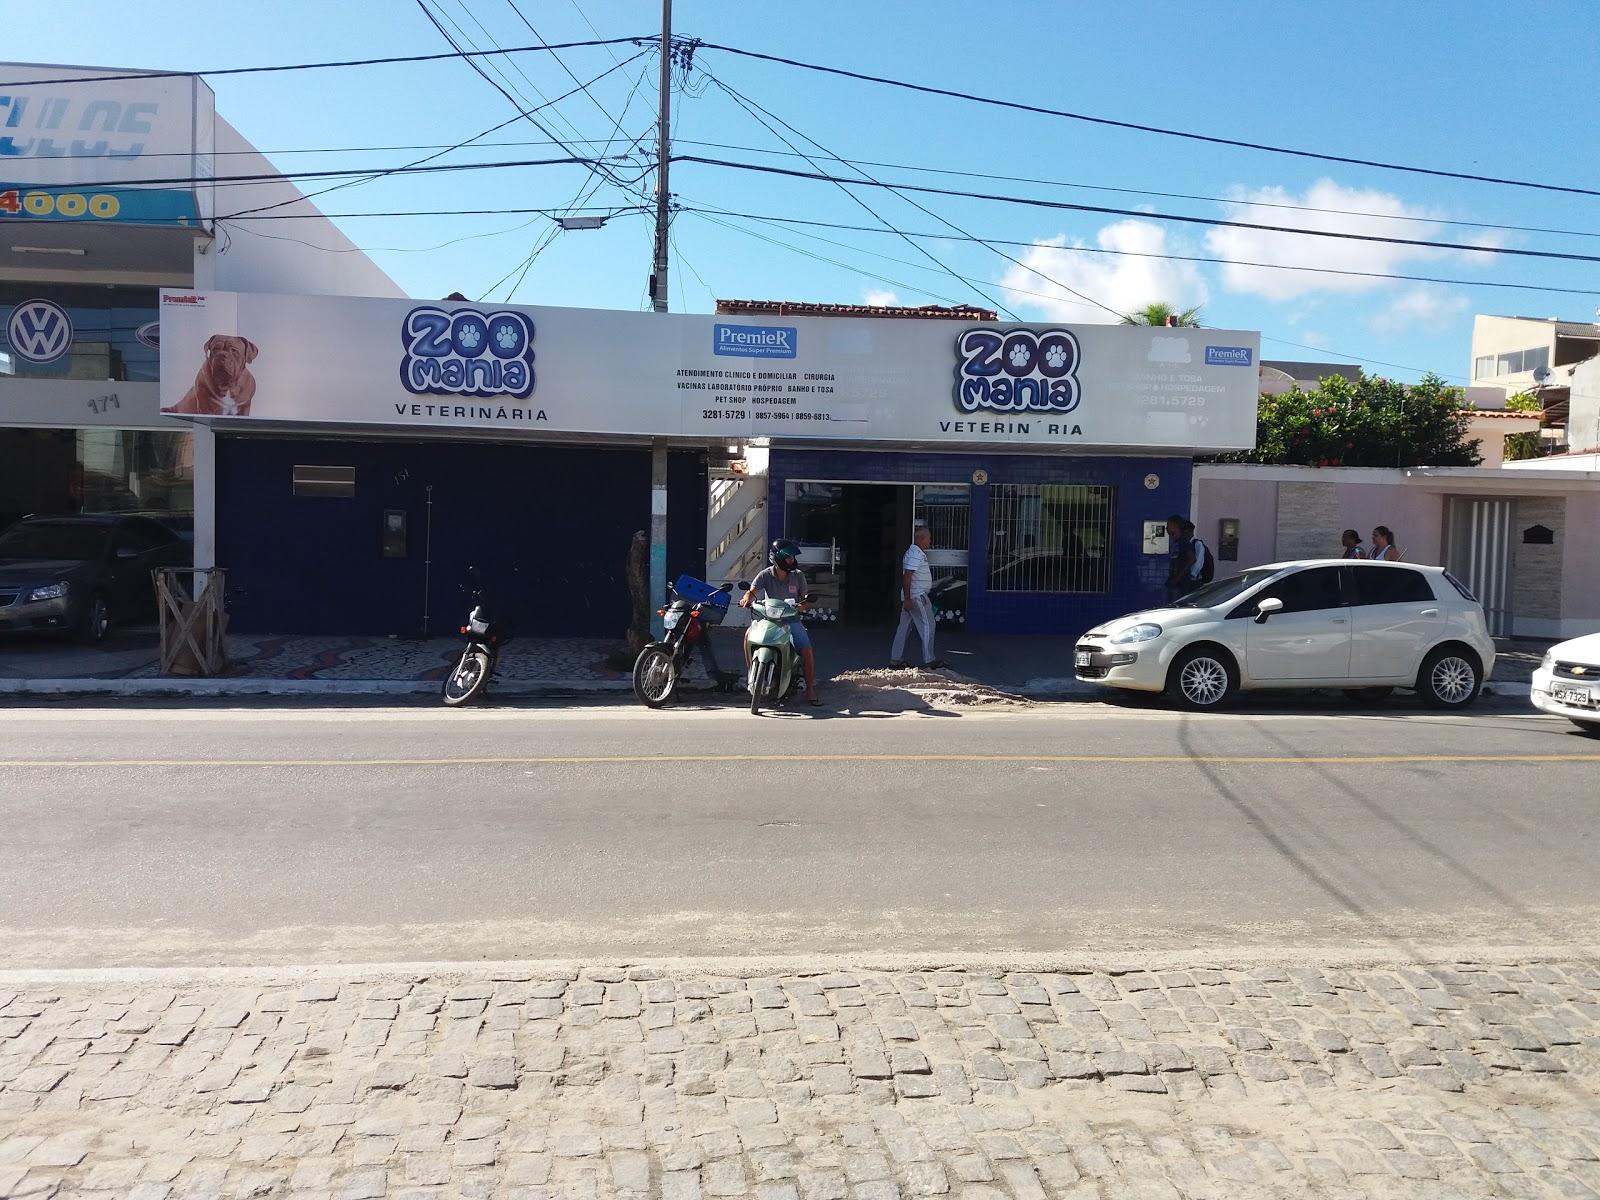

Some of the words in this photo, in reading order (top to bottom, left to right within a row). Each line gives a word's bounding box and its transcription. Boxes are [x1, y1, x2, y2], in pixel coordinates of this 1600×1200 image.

[411, 313, 526, 359] ZOO
[720, 327, 791, 349] PremieR
[719, 345, 748, 353] Alimentos
[964, 333, 1074, 378] ZOO
[676, 369, 723, 378] ATENDIMENTO
[758, 372, 797, 380] DOMICILIAR
[804, 373, 835, 381] CIRURGIA
[677, 382, 706, 390] VACINAS
[707, 383, 752, 392] LABORATÓRIO
[754, 384, 783, 392] PRÓPRIO
[788, 385, 810, 393] BANHO
[811, 385, 816, 393] E
[818, 386, 834, 394] TOSA
[729, 396, 747, 404] SHOP
[752, 397, 797, 405] HOSPEDAGEM
[395, 404, 548, 421] VETERINÁRIA
